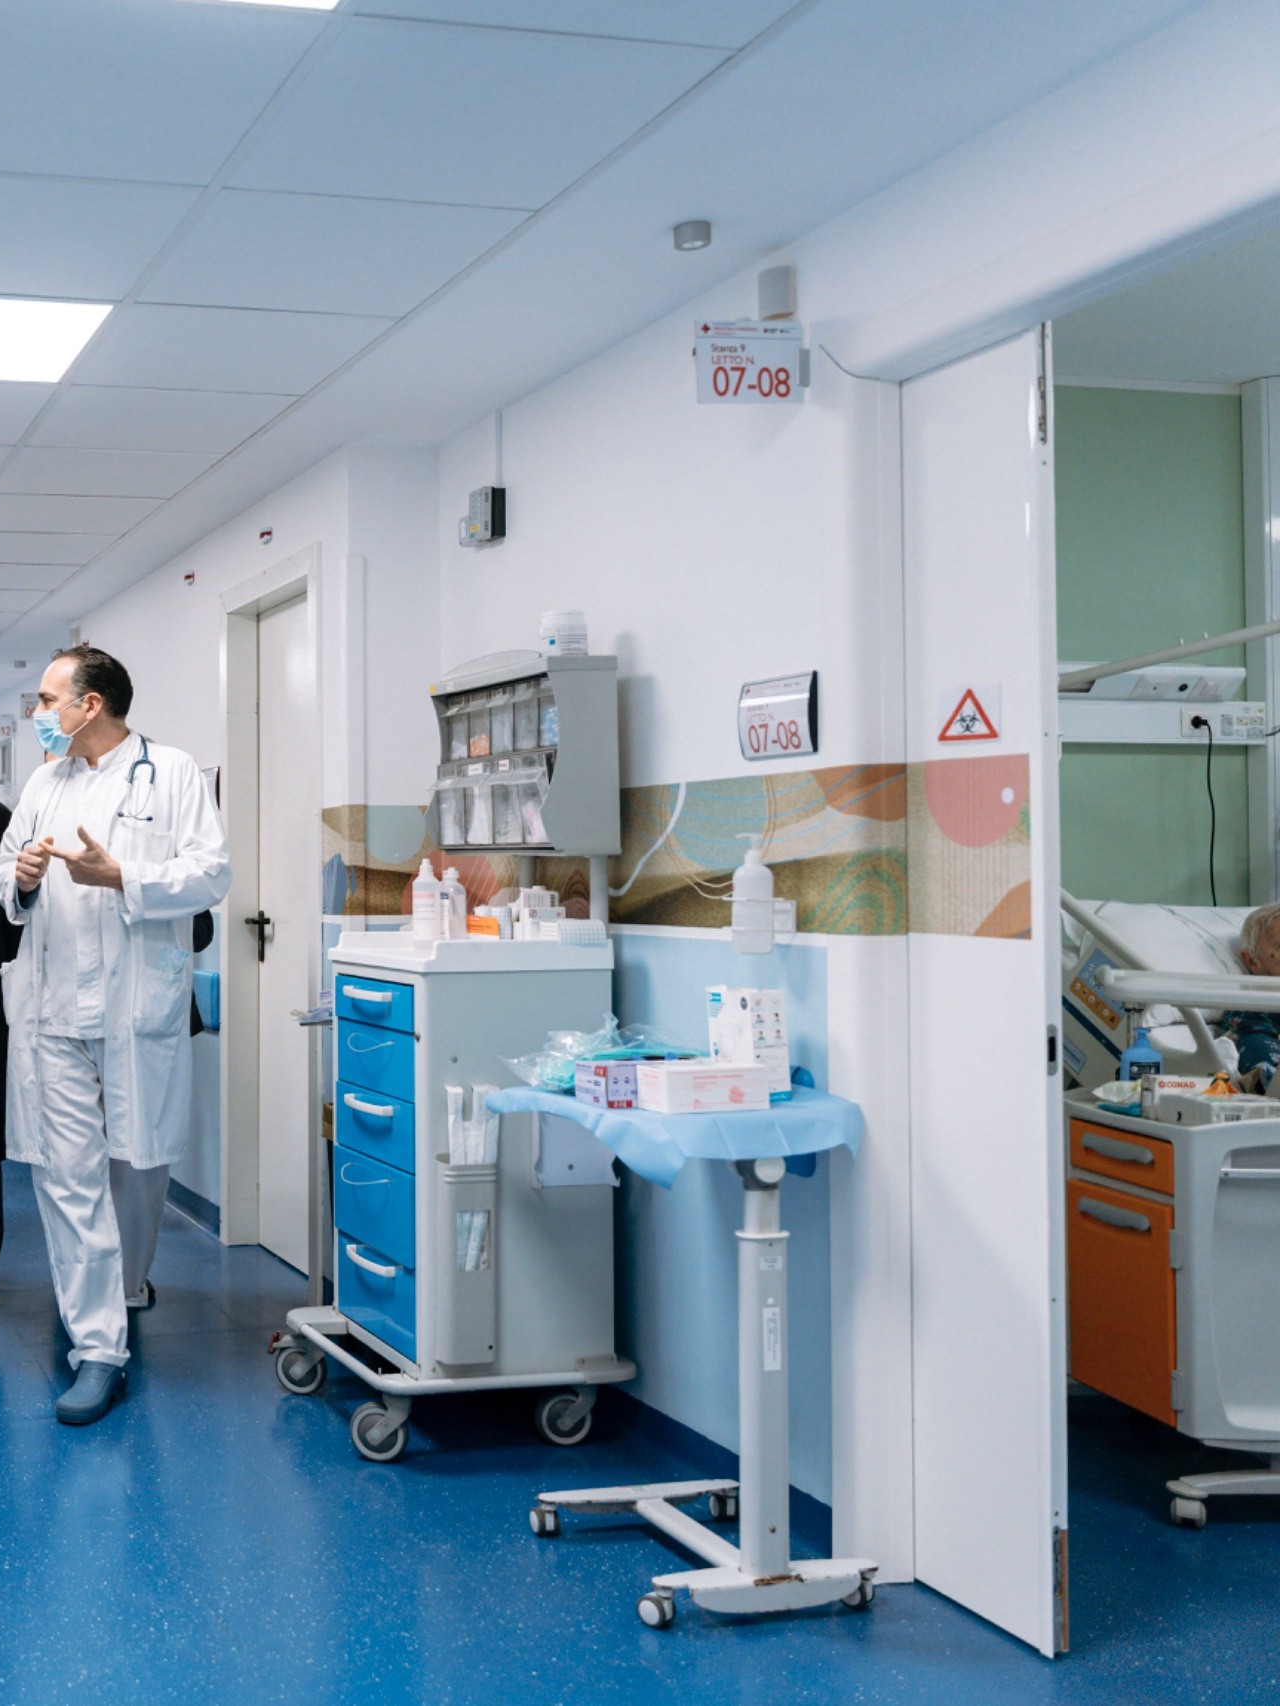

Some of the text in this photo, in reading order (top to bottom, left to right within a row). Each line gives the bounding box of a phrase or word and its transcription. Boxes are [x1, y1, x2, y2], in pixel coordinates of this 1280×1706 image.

[711, 343, 738, 353] Stanza
[711, 355, 743, 365] LETTO
[712, 366, 791, 398] 07-08
[748, 719, 802, 753] 07-08
[1166, 1080, 1197, 1089] CONAD
